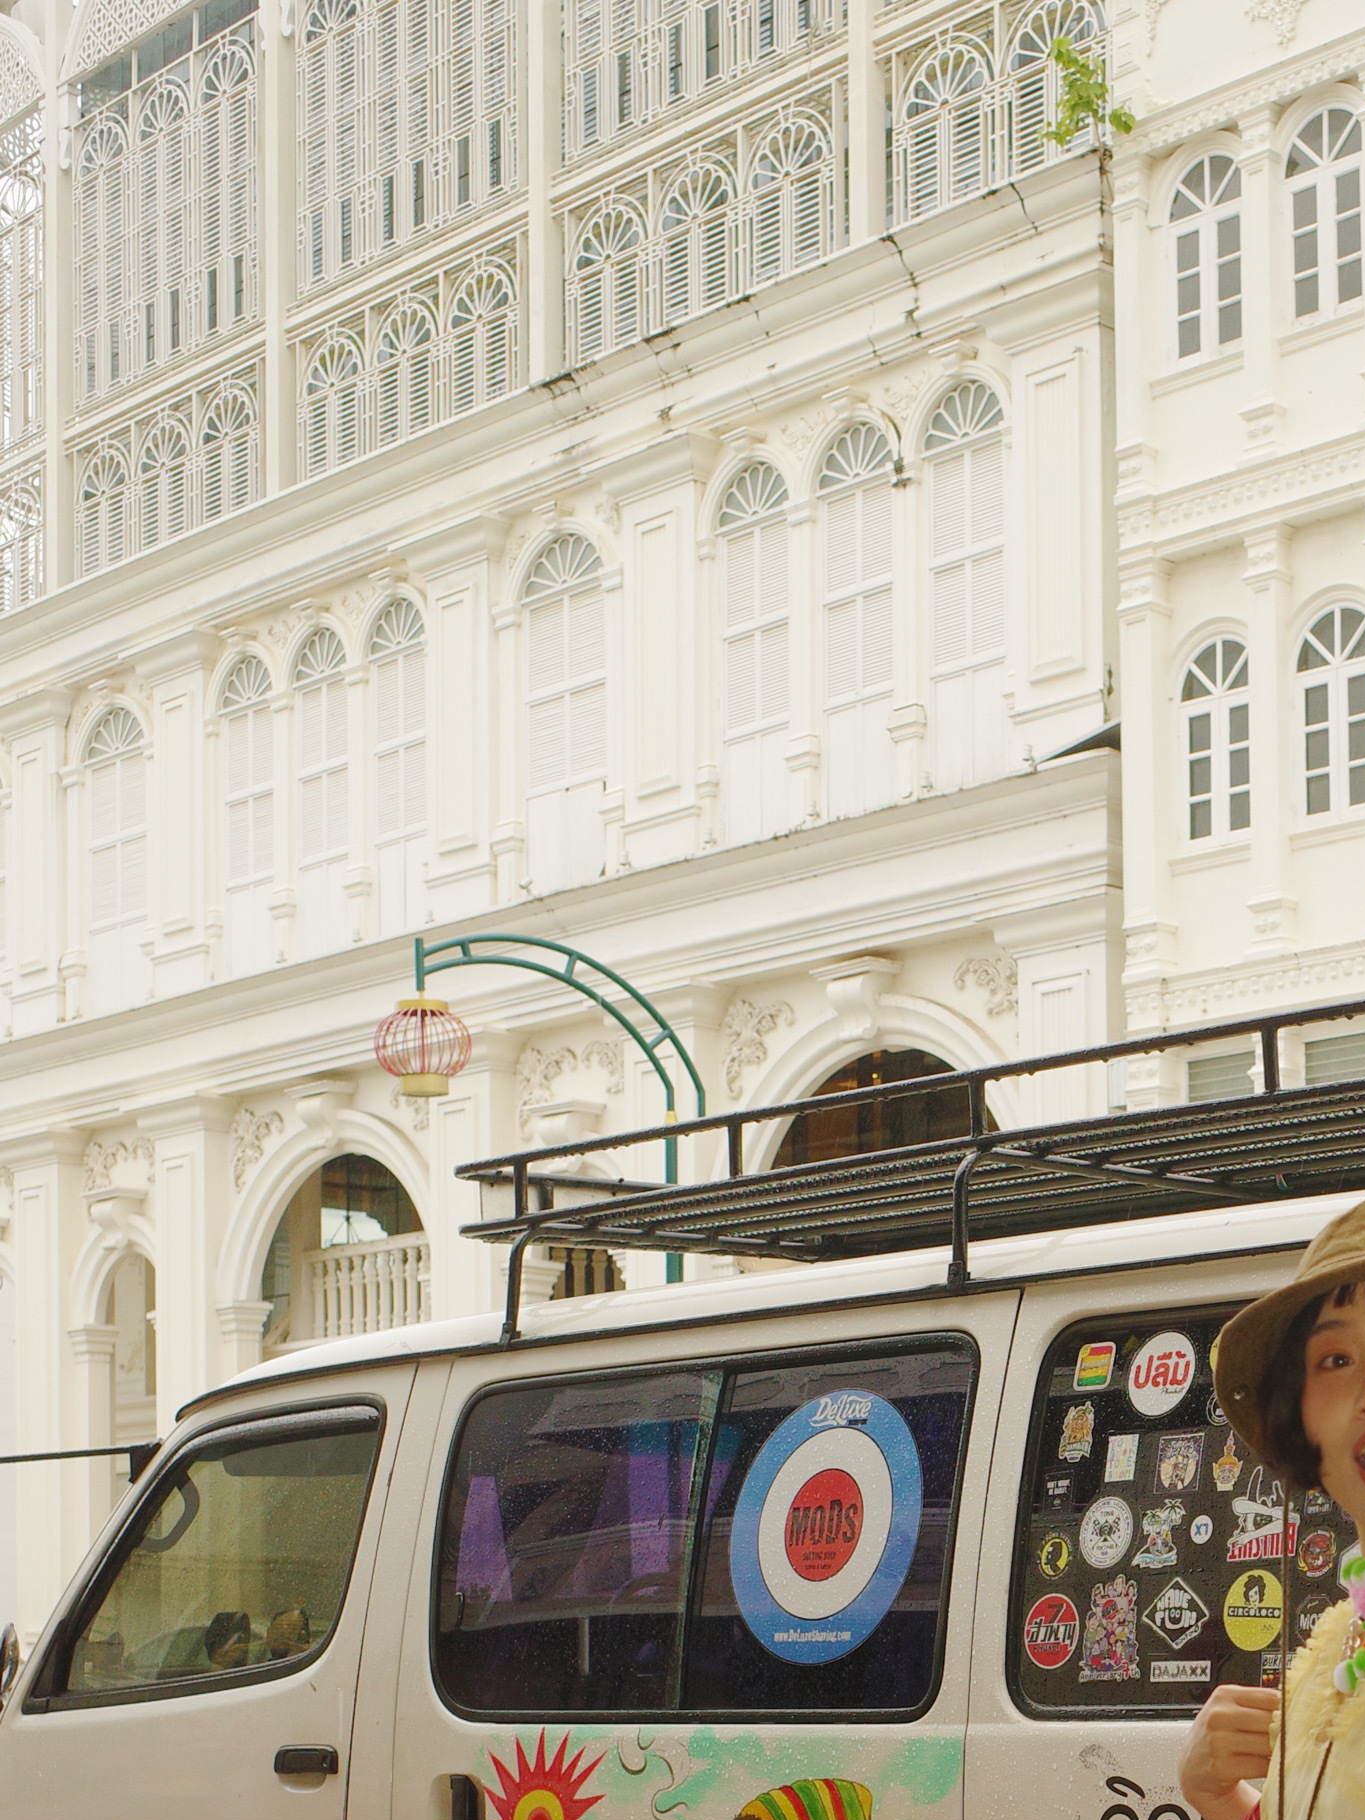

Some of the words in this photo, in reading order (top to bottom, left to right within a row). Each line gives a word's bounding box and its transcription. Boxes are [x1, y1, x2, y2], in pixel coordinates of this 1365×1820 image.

[810, 1394, 873, 1427] DeLuxe
[789, 1499, 859, 1547] MODS
[1156, 1588, 1192, 1610] HAVE
[1155, 1608, 1196, 1630] FUN
[1228, 1608, 1281, 1618] CIRCOLOCO
[1079, 1670, 1122, 1682] Anniversary
